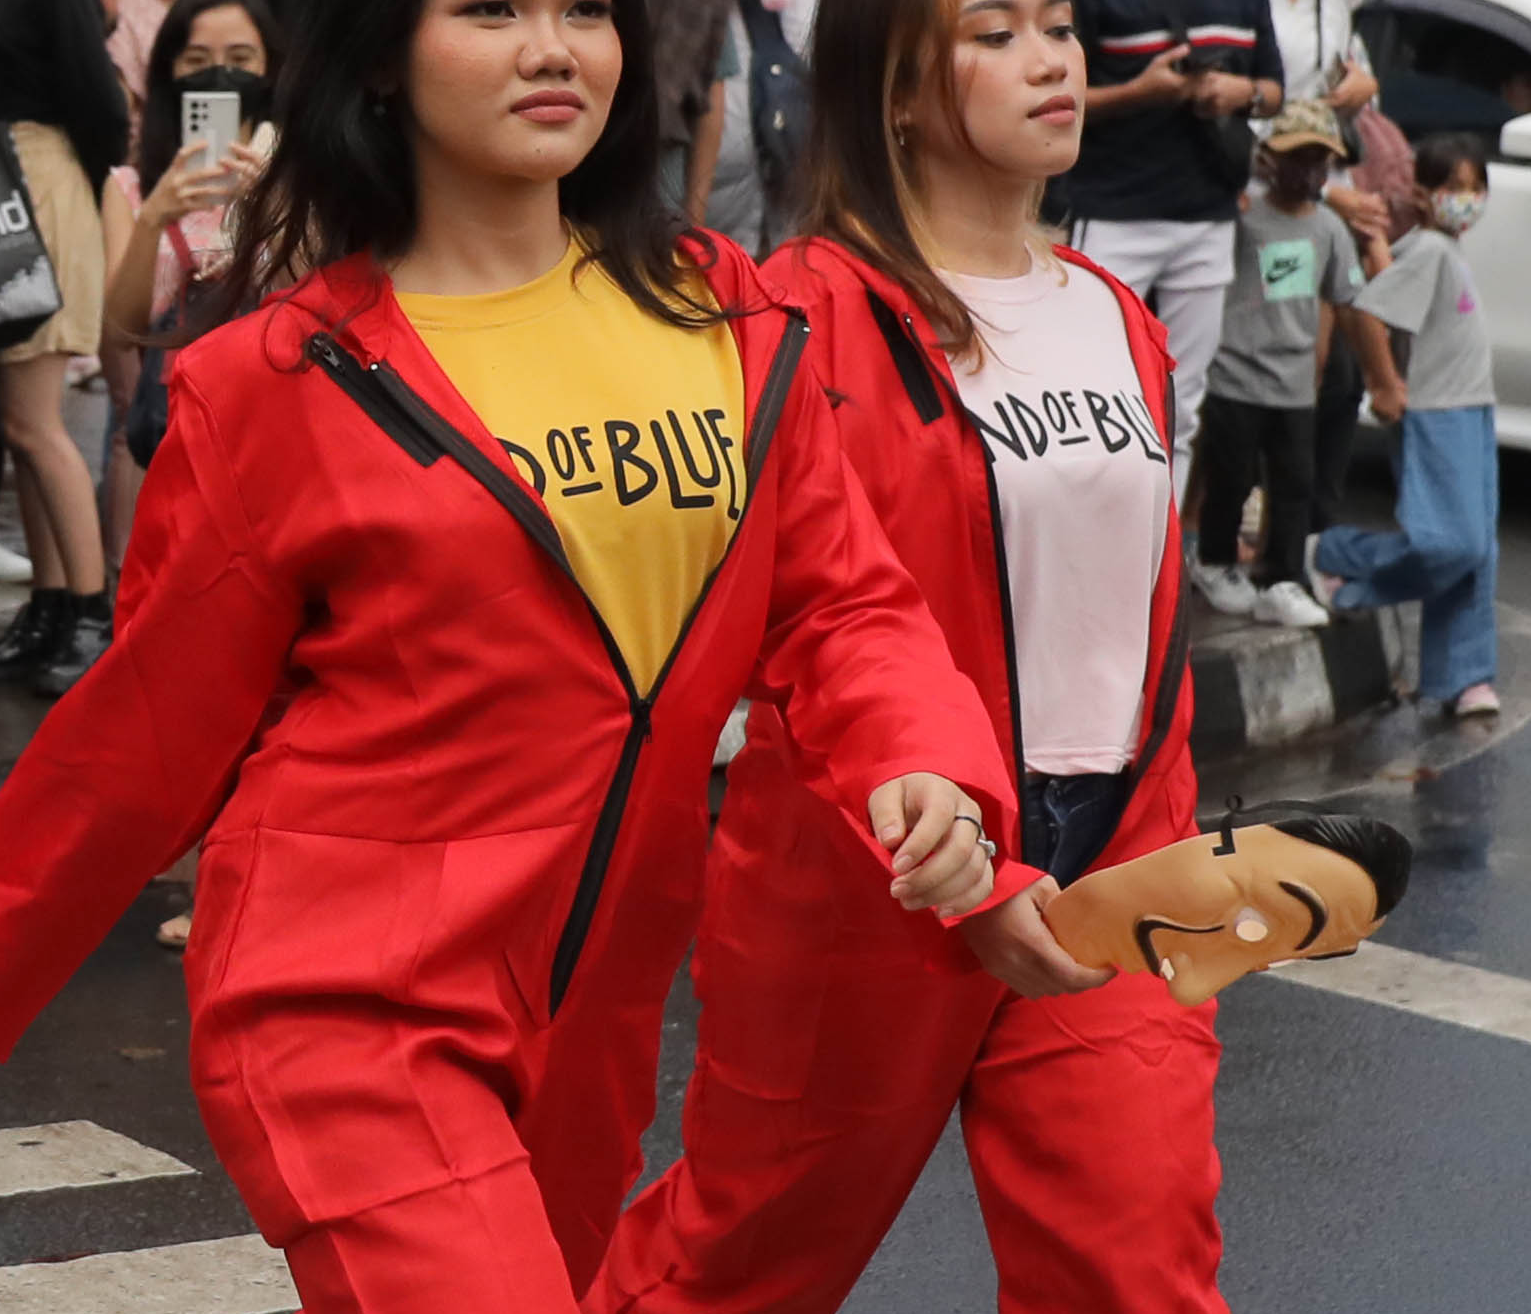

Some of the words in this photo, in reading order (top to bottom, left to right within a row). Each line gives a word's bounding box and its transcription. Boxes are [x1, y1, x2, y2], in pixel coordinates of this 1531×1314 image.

[547, 427, 598, 489] OF
[962, 391, 1049, 463] ND
[1042, 391, 1085, 439] OF
